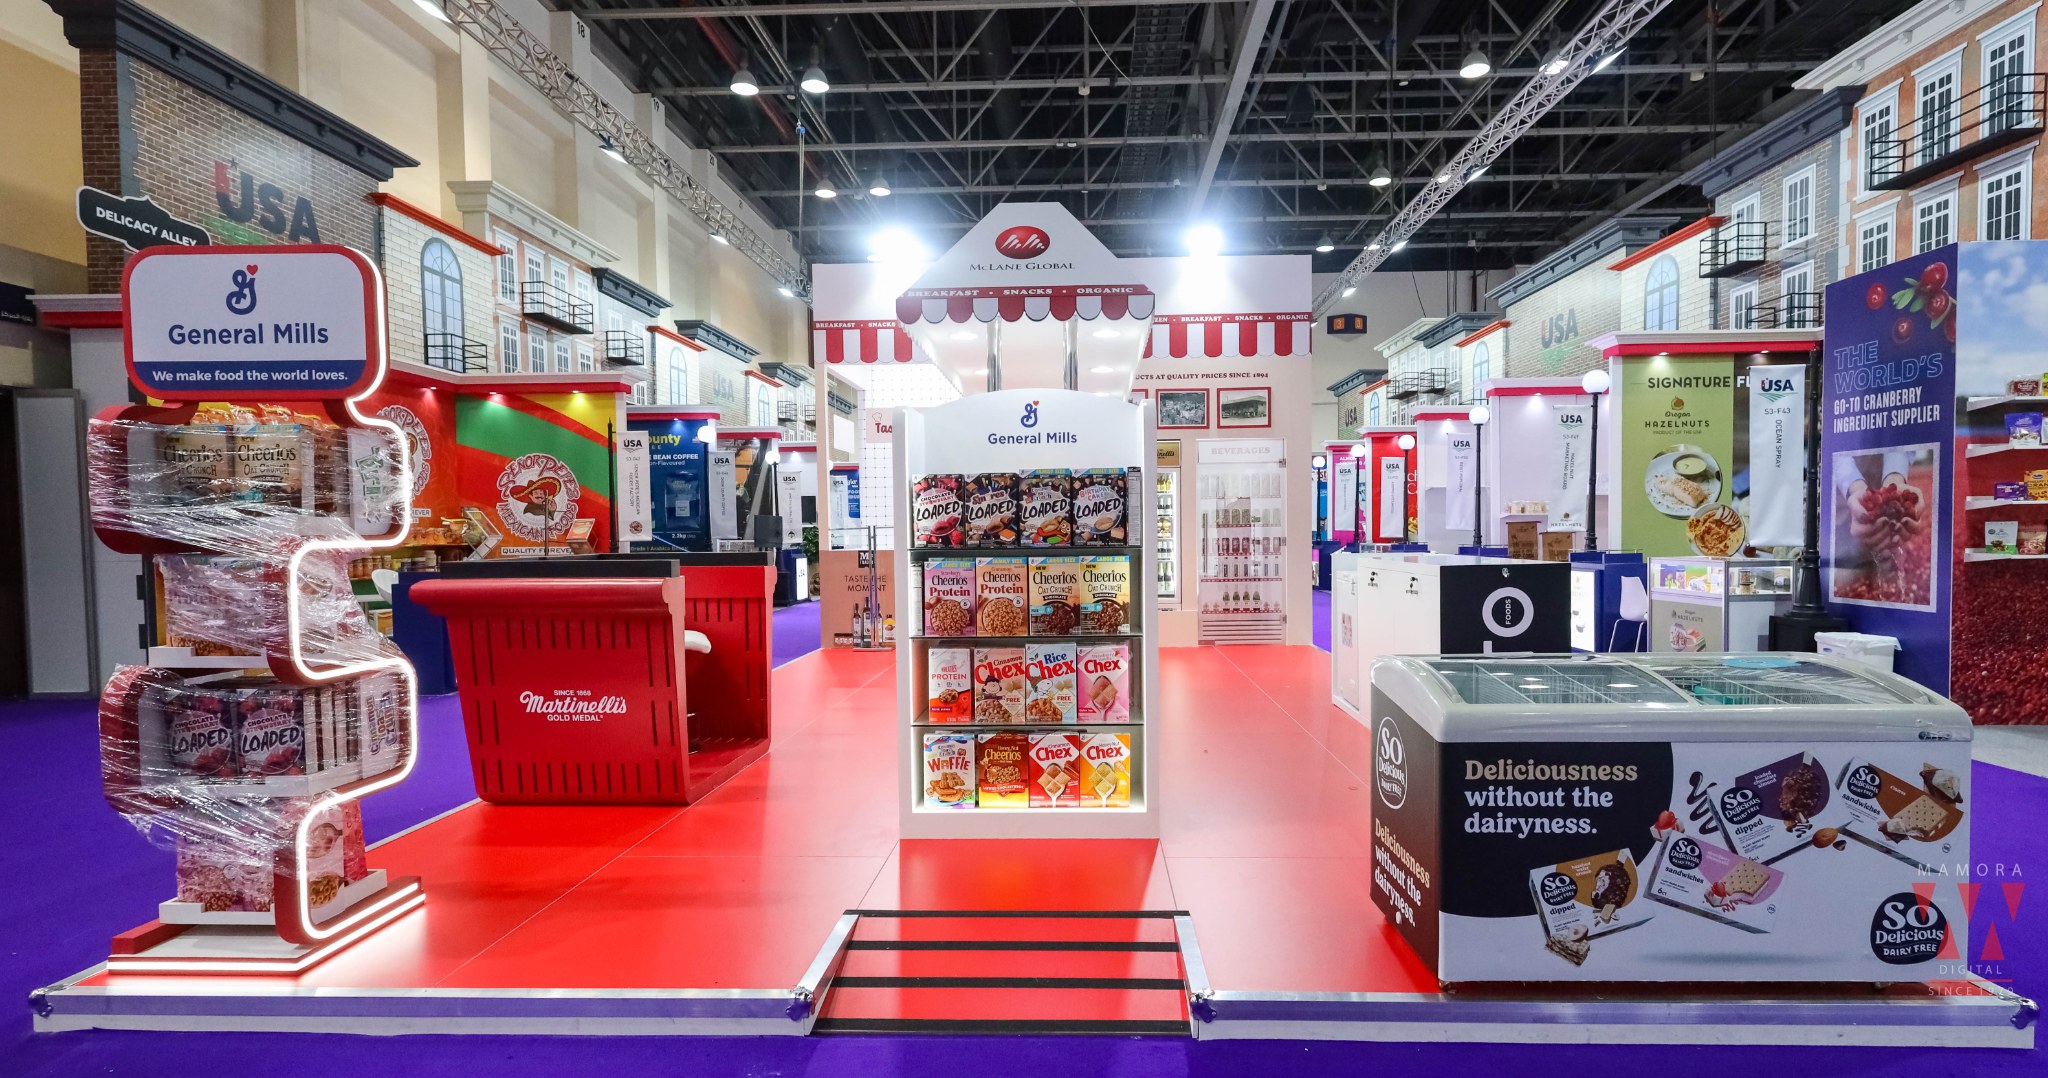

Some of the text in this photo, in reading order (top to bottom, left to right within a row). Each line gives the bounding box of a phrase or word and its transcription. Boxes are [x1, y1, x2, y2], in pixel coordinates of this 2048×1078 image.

[577, 20, 585, 38] 18
[653, 98, 660, 112] 19
[214, 158, 321, 244] USA
[96, 206, 198, 246] DELICACY ALLEY
[1025, 261, 1076, 270] GLOBAL
[168, 323, 329, 345] General Mills
[1541, 307, 1579, 349] USA
[1834, 340, 1879, 370] THE
[152, 370, 348, 381] We make food the world loves.
[1648, 376, 1731, 388] SIGNATURE
[1834, 353, 1943, 394] WORLD'S
[713, 374, 734, 402] USA
[1761, 378, 1795, 392] USA
[1834, 386, 1922, 415] GO-TO CRANBERRY
[1345, 407, 1357, 427] USA
[1561, 414, 1583, 423] USA
[1665, 411, 1691, 419] Oregon
[1834, 404, 1940, 433] INGREDIENT SUPPLIER
[1645, 420, 1710, 428] HAZELNUTS
[623, 438, 643, 448] USA
[987, 432, 1077, 445] General Mills
[1453, 440, 1471, 448] USA
[238, 443, 297, 462] Cheerios
[1211, 447, 1271, 455] BEVERAGES
[920, 492, 952, 501] CHOCOLATE
[1080, 487, 1111, 498] BIRTHDAY
[916, 500, 960, 521] LOADED
[969, 500, 1014, 520] LOADED
[1022, 499, 1067, 519] LOADED
[1076, 498, 1121, 519] LOADED
[932, 575, 968, 586] Cheerios
[982, 571, 1021, 582] Cheerios
[1033, 571, 1078, 585] Cheerios
[1083, 570, 1127, 582] Cheerios
[930, 587, 971, 597] Protein
[980, 583, 1024, 594] Protein
[1038, 585, 1073, 594] OAT CRUNCH
[1088, 584, 1122, 592] OAT CRUNCH
[994, 656, 1023, 666] Cinnamon
[1043, 653, 1068, 665] Rice
[1084, 659, 1122, 674] Chex
[975, 661, 1026, 685] Chex
[1025, 660, 1076, 680] Chex
[519, 690, 627, 713] Martinelli's
[174, 715, 215, 729] CHOCOLATE
[247, 713, 288, 727] CHOCOLATE
[171, 728, 229, 756] LOADED
[242, 726, 301, 754] LOADED
[1381, 727, 1403, 765] SO
[985, 749, 1022, 761] Cheerios
[1036, 747, 1073, 761] Chex
[1086, 745, 1123, 760] Chex
[1379, 756, 1405, 785] Delicious
[1464, 758, 1638, 781] Deliciousness
[1856, 767, 1880, 786] SO
[1381, 778, 1402, 797] DAIRY FREE
[1849, 777, 1879, 793] Delicious
[1464, 785, 1614, 807] without the
[1723, 789, 1753, 809] SO
[1842, 793, 1881, 816] sandwiches
[1725, 797, 1761, 818] Delicious
[1733, 805, 1760, 822] DAIRY FREE
[1464, 811, 1598, 839] dairyness.
[1735, 818, 1764, 836] dipped
[1375, 817, 1430, 888] Deliciousness
[1676, 840, 1700, 856] SO
[1670, 850, 1700, 864] Delicious
[1375, 845, 1421, 906] without the
[1543, 875, 1571, 891] SO
[1665, 866, 1704, 884] sandwiches
[1375, 866, 1416, 927] dairyness.
[1544, 884, 1577, 899] Delicious
[1549, 903, 1576, 915] dipped
[1882, 901, 1938, 930] SO
[1875, 928, 1944, 945] Delicious
[1883, 944, 1937, 956] DAIRY FREE
